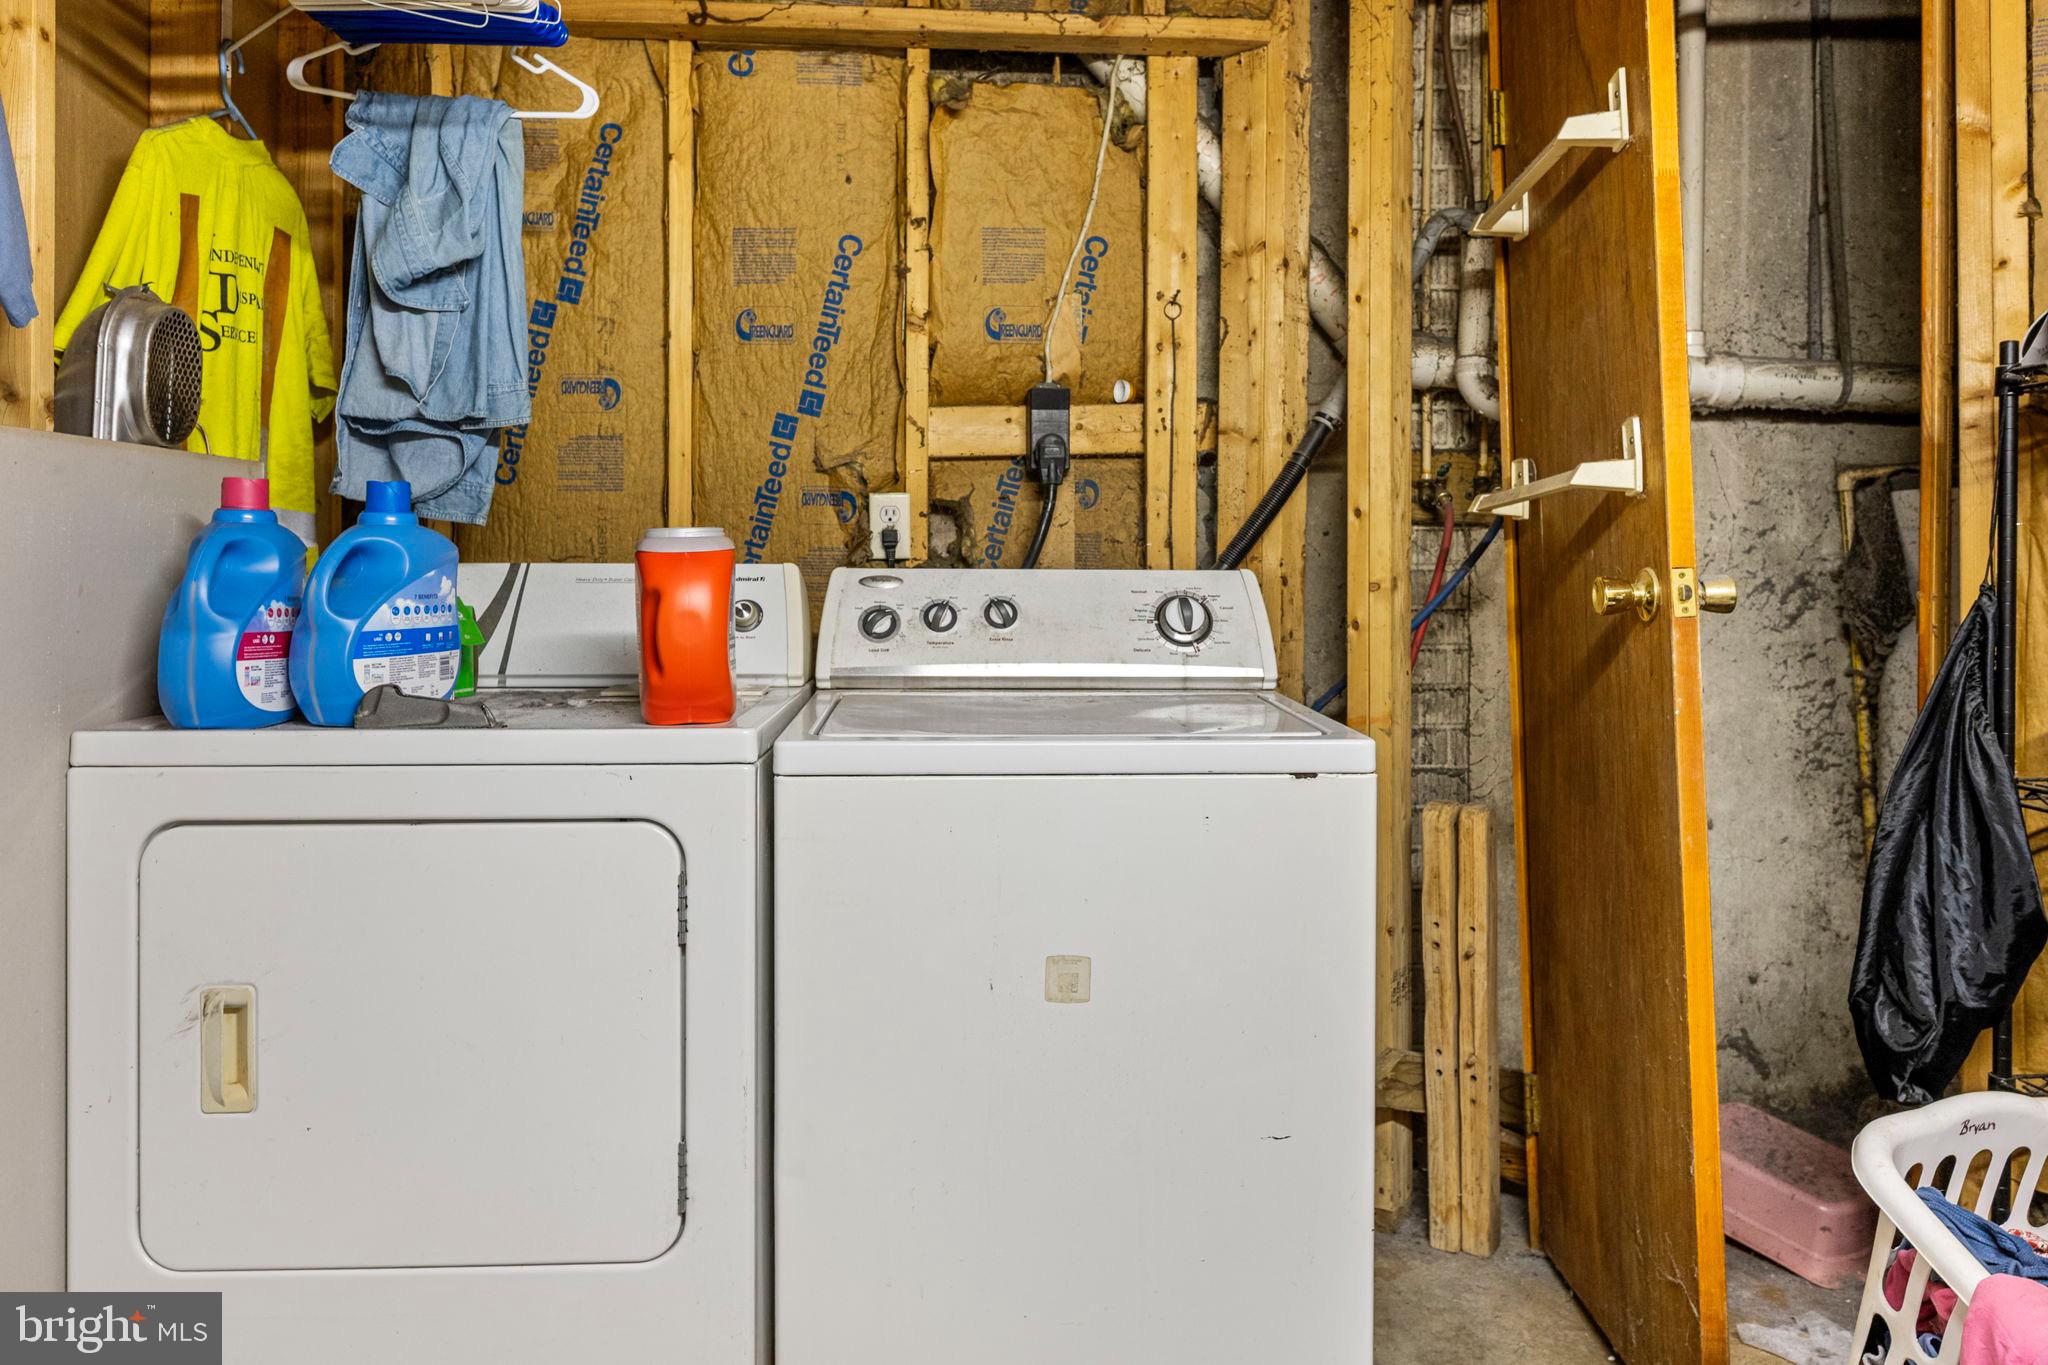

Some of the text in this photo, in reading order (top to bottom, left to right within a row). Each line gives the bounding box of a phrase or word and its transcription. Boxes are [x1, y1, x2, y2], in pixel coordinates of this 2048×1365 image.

[563, 122, 623, 277] CertainTeed
[804, 233, 864, 390] CertainTeed
[1959, 1119, 1996, 1136] Bryan
